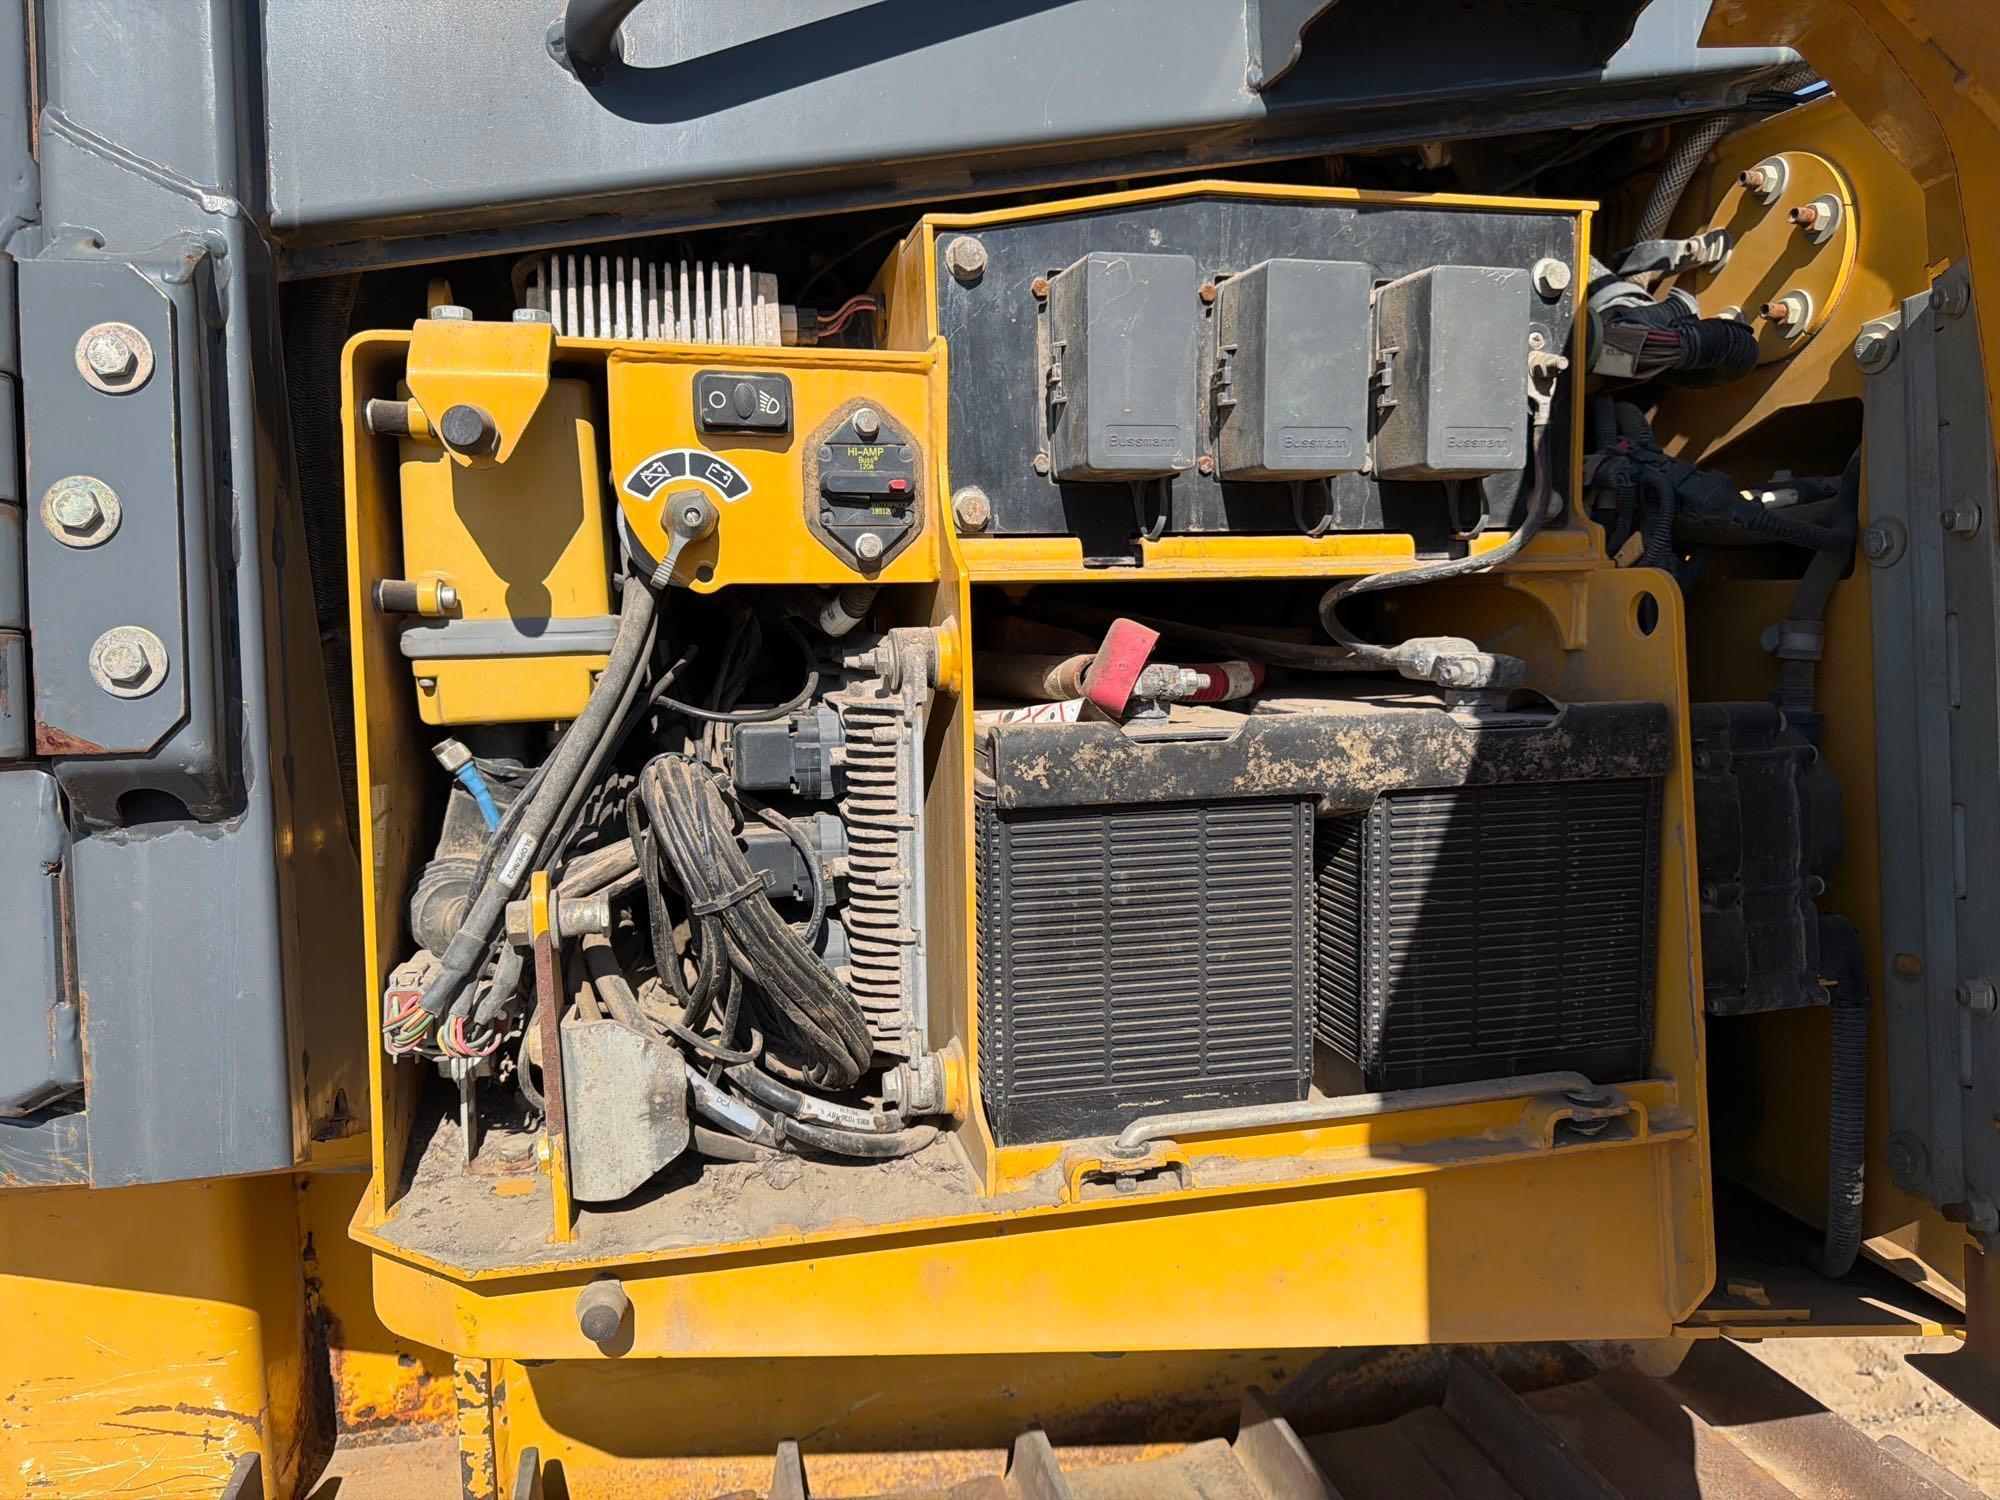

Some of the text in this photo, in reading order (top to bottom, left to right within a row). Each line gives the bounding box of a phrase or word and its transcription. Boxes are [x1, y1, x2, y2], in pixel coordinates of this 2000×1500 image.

[1108, 434, 1176, 448] Bussmann
[1283, 436, 1347, 449] Bussmann
[1446, 436, 1509, 449] Bussmann
[847, 447, 884, 456] HI-AMP
[715, 1095, 730, 1110] DCA
